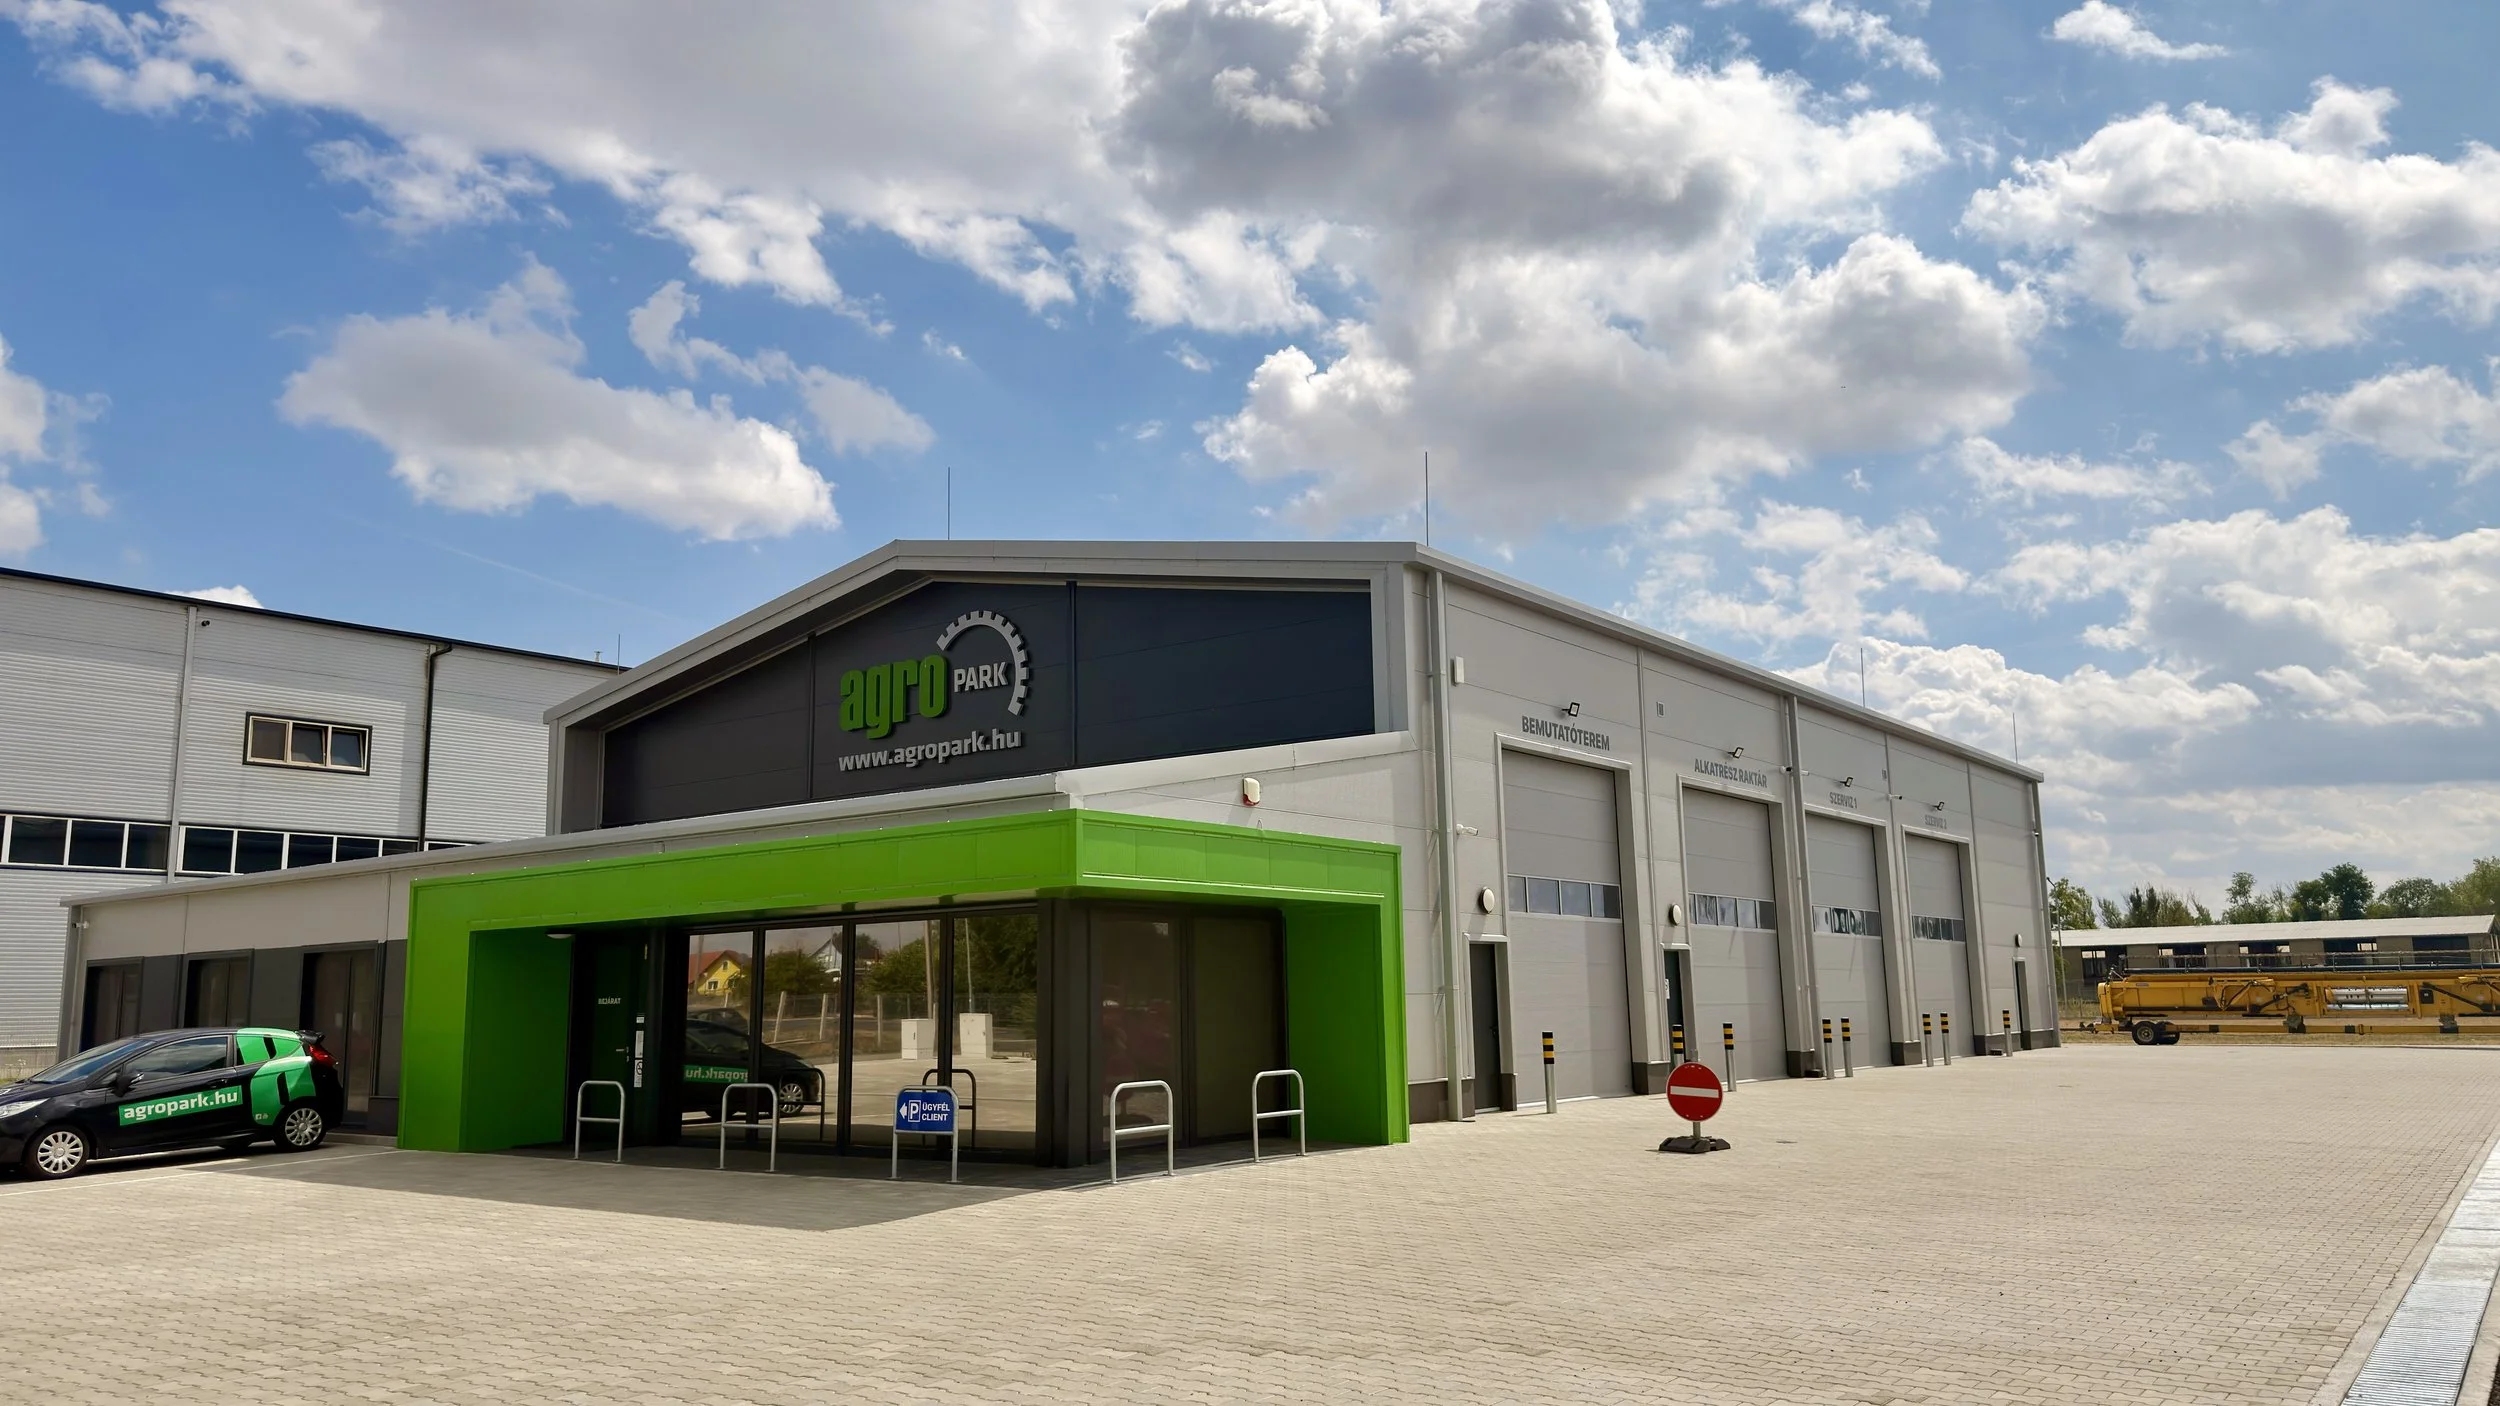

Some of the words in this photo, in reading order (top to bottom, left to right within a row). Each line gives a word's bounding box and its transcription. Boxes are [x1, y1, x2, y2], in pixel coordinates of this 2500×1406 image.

[840, 654, 948, 739] agro
[953, 661, 1008, 693] PARK
[1522, 715, 1610, 751] BEMUTATÓTEREM
[838, 728, 1022, 772] www.agropark.hu
[1694, 758, 1738, 781] ALKATRÉSZ
[1738, 769, 1768, 788] RAKTÁR
[124, 1091, 238, 1120] agropark.hu
[921, 1113, 948, 1121] CLIENT
[922, 1102, 951, 1111] ÜGYFÉL
